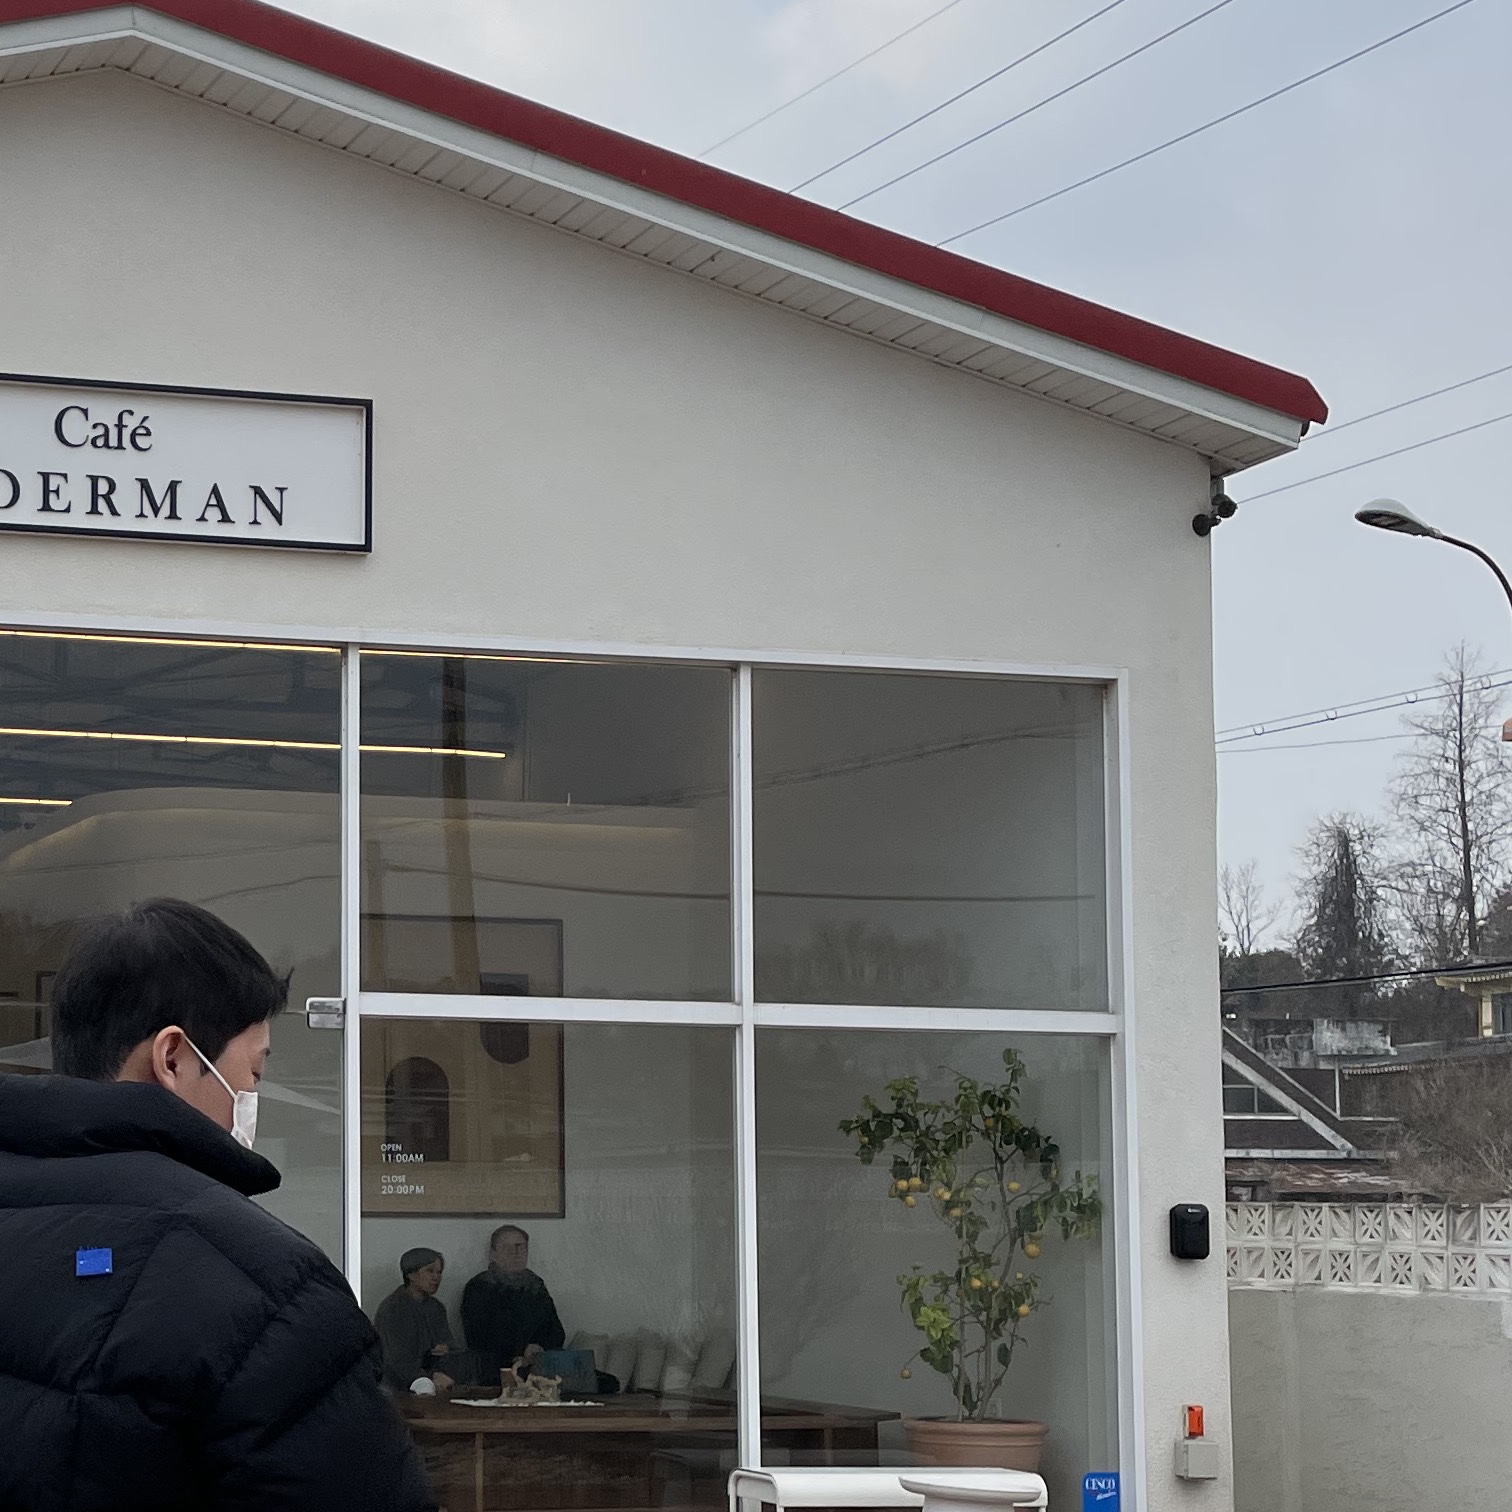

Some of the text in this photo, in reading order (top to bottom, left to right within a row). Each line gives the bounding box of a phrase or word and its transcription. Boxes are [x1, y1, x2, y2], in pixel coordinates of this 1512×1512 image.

[53, 405, 153, 452] Café
[380, 1143, 403, 1152] OPEN
[381, 1153, 425, 1163] 11:00AM
[381, 1174, 407, 1184] CLOSE
[381, 1185, 425, 1195] 20:00PM
